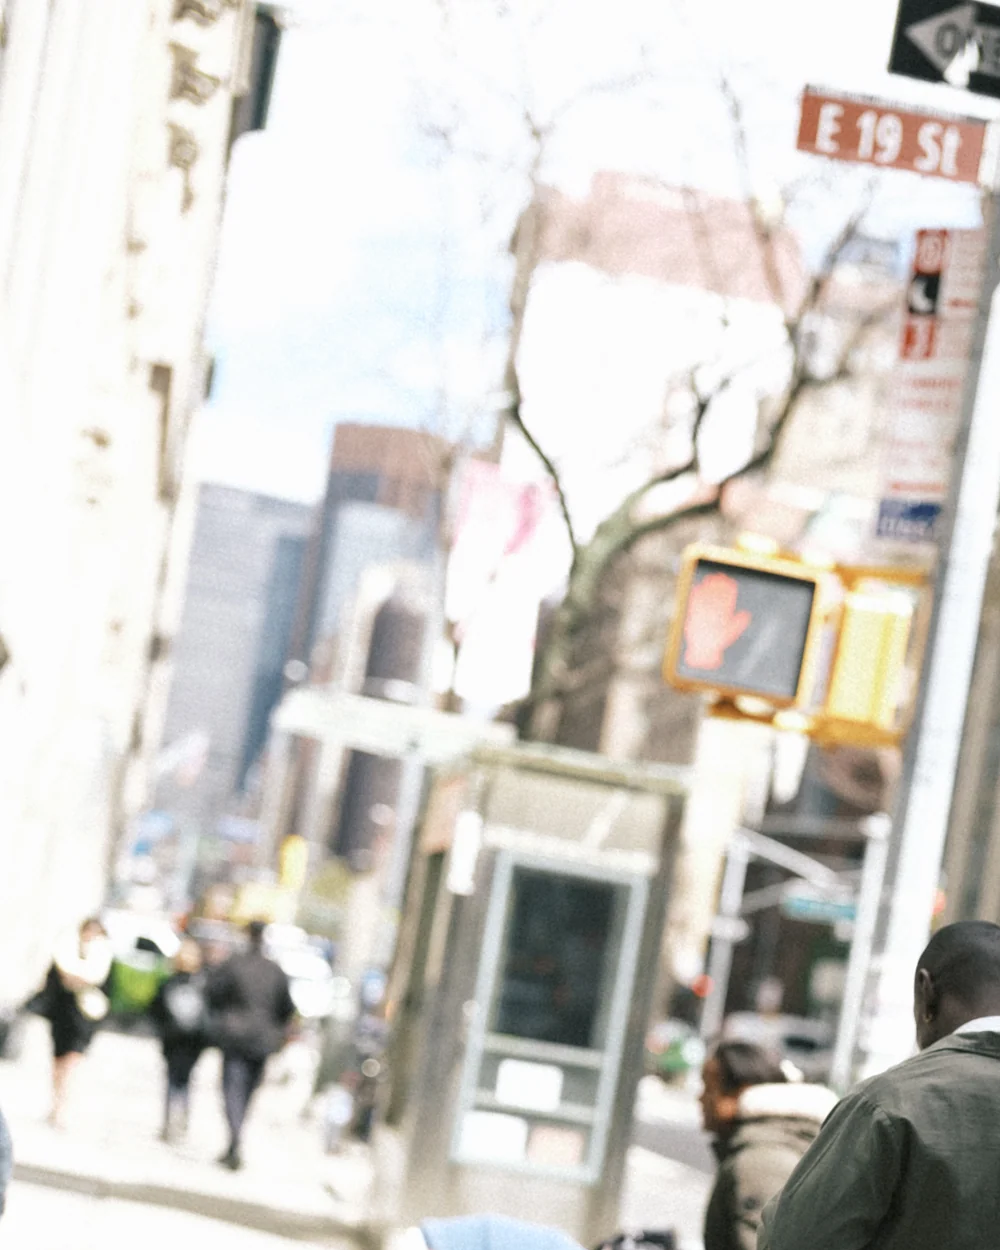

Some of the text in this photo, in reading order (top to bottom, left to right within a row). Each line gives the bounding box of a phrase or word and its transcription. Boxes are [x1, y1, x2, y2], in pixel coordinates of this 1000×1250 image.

[815, 102, 962, 176] E 19 St
